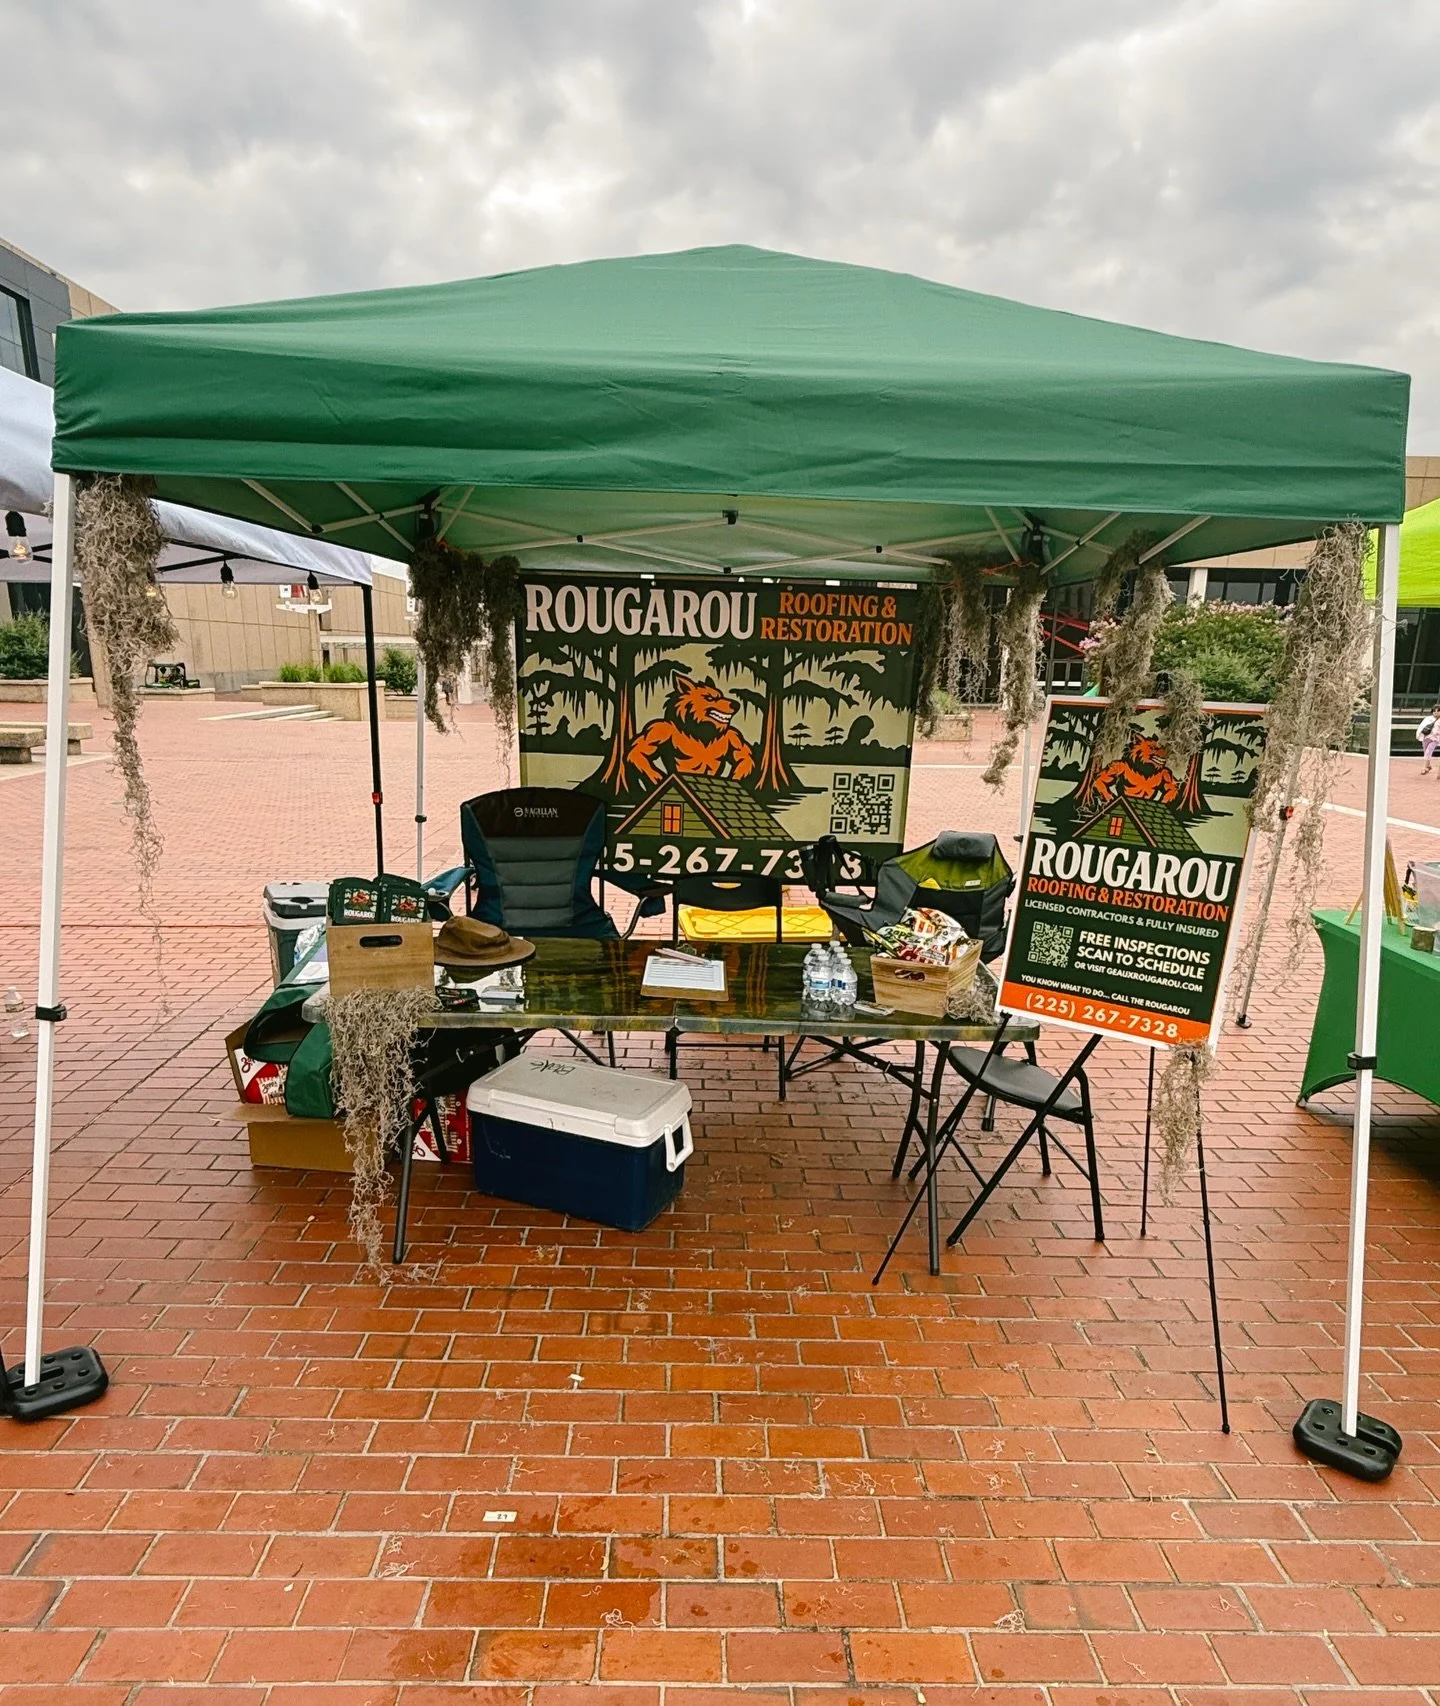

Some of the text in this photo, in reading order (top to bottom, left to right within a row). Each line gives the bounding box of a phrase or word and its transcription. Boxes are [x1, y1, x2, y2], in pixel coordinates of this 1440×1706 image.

[524, 584, 758, 640] ROUGAROU
[779, 592, 897, 618] ROOFING &
[760, 617, 913, 645] RESTORATION
[594, 843, 862, 881] 5-267-738
[1029, 837, 1236, 902] ROUGAROU
[1024, 899, 1219, 938] LICENSED CONTRACTORS & FULLY INSURED
[1027, 877, 1229, 922] ROOFING & RESTORATION
[1077, 945, 1206, 980] SCAN TO SCHEDULE
[1079, 930, 1211, 965] FREE INSPECTIONS
[1021, 974, 1036, 983] YOU
[1036, 978, 1060, 988] KNOW
[1060, 982, 1081, 992] WHAT
[1081, 986, 1092, 995] TO
[1111, 993, 1130, 1003] CALL
[1130, 996, 1145, 1006] THE
[1145, 999, 1190, 1015] ROUGAROU
[1074, 961, 1203, 992] OR VISIT GEAUXROUGAROU.COM
[1026, 992, 1178, 1038] (225) 267-7328
